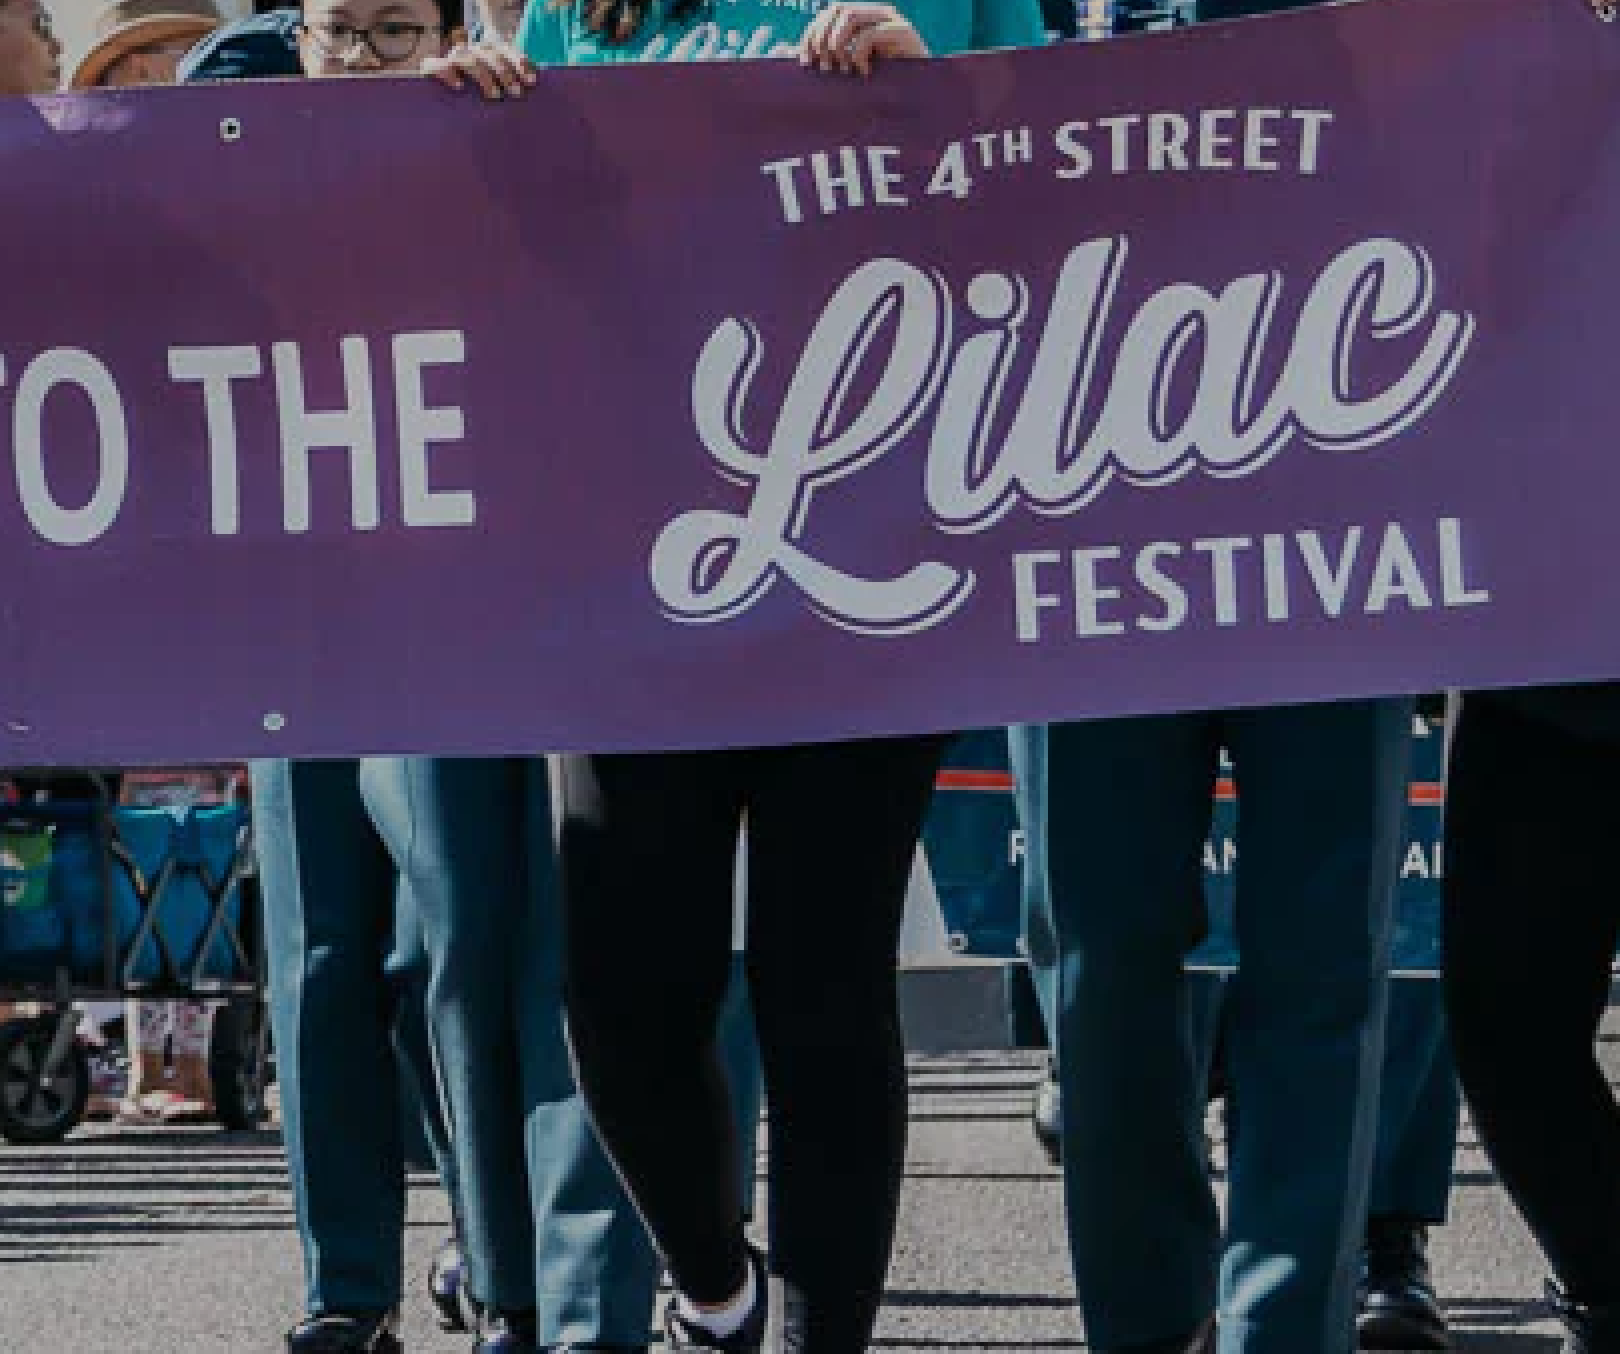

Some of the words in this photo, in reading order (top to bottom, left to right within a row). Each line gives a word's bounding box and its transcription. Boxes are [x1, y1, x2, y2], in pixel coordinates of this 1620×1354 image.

[760, 145, 909, 224] THE
[925, 126, 1034, 200] 4TH
[1054, 109, 1333, 180] STREET
[167, 330, 476, 535] THE
[649, 233, 1476, 635] Lilac
[1013, 517, 1491, 642] FESTIVAL
